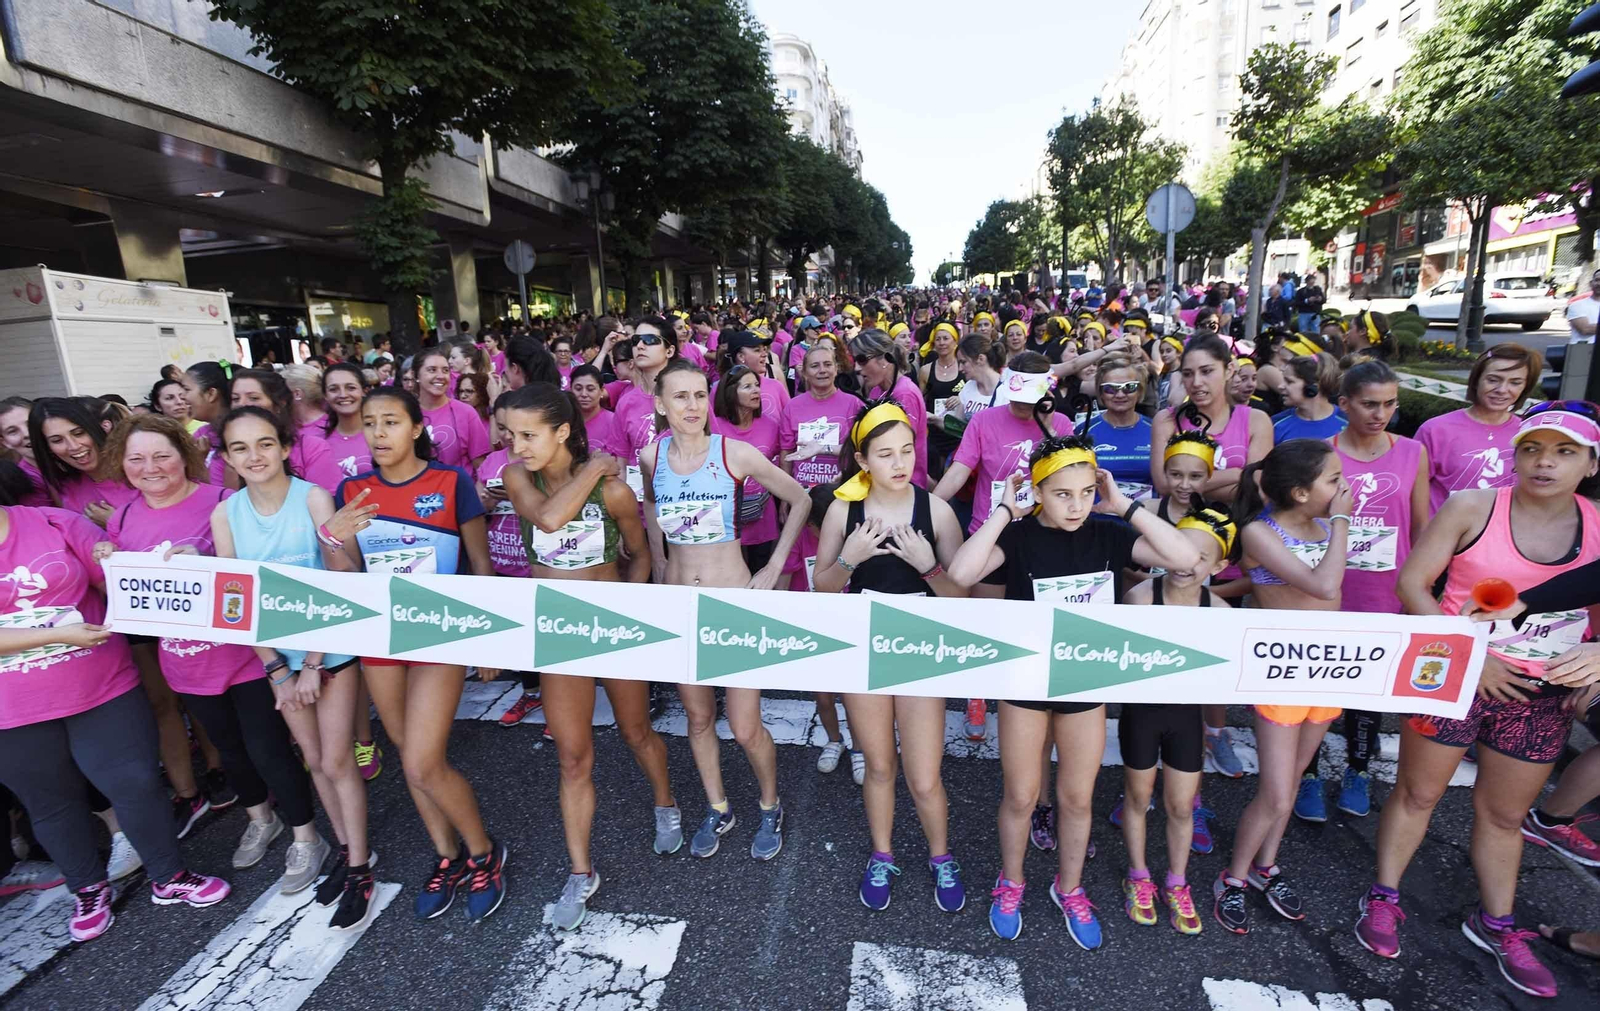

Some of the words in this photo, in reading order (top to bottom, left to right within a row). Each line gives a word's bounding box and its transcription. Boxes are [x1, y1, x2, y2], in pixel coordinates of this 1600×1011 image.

[798, 462, 838, 474] CARRERA
[797, 472, 834, 484] FEMENIN
[679, 490, 728, 501] Atletismo
[681, 515, 699, 527] 274
[559, 538, 578, 550] 143
[1352, 541, 1371, 552] 233
[119, 577, 202, 596] CONCELLO
[130, 595, 150, 609] DE
[156, 597, 192, 612] VIGO
[261, 594, 275, 610] El
[275, 596, 306, 614] Corte
[306, 594, 353, 621] Inglés
[392, 604, 407, 621] El
[407, 607, 441, 625] Corte
[441, 605, 492, 633] Inglés
[537, 615, 554, 633] El
[553, 618, 590, 636] Corte
[591, 616, 646, 645] Inglés
[1523, 622, 1551, 639] 718
[699, 626, 717, 645] El
[717, 628, 757, 648] Corte
[758, 626, 818, 656] Inglés
[872, 635, 891, 653] El
[891, 637, 934, 655] Corte
[935, 635, 998, 664] Inglés
[1053, 642, 1073, 660] El
[1073, 644, 1118, 662] Corte
[1119, 641, 1186, 672] Inglés
[1253, 641, 1385, 662] CONCELLO
[1267, 665, 1299, 679] DE
[1308, 666, 1362, 680] VIGO
